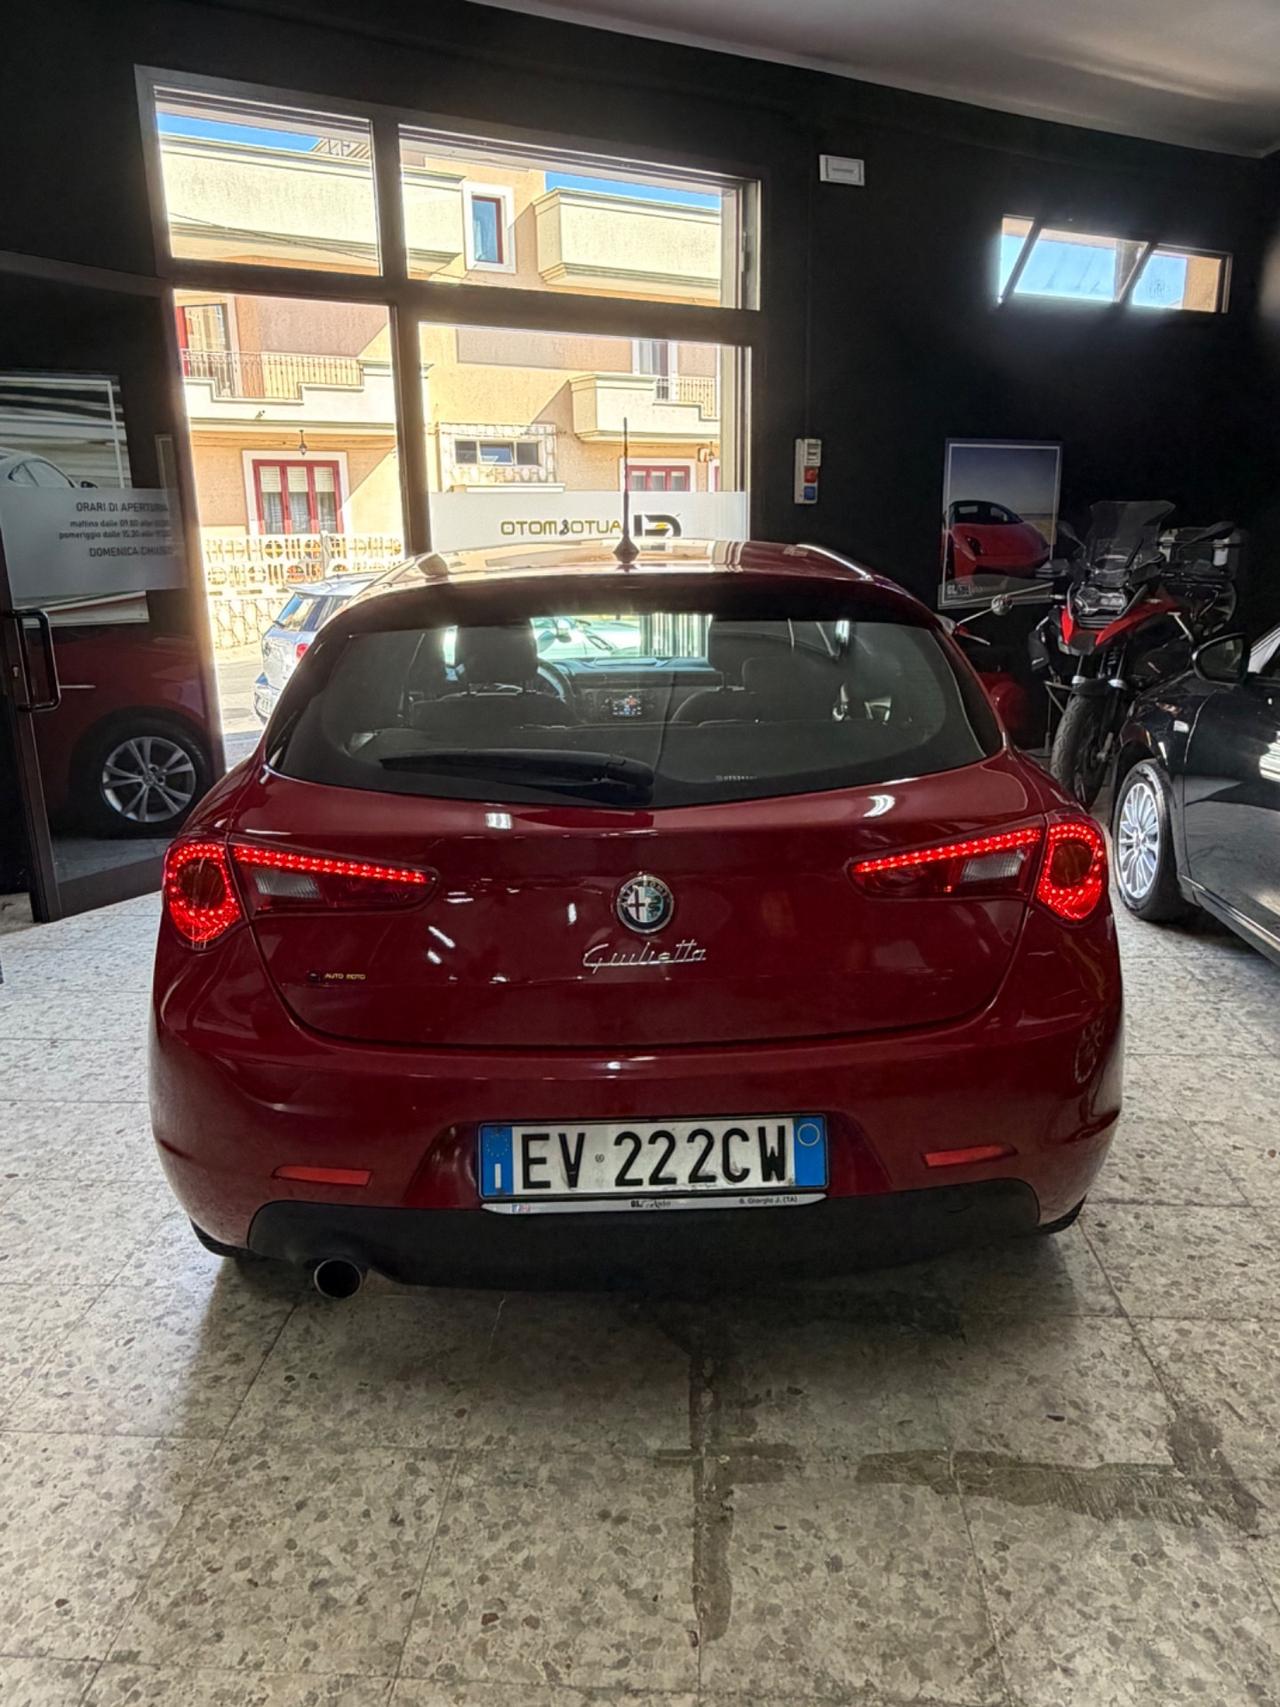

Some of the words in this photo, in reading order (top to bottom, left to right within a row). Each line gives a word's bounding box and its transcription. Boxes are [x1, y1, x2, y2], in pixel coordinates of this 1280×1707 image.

[76, 502, 106, 512] ORARI
[109, 502, 118, 512] DI
[89, 546, 139, 557] DOMENICA
[583, 939, 707, 974] Giulietta
[521, 1132, 586, 1189] EV
[614, 1125, 786, 1187] 222CW
